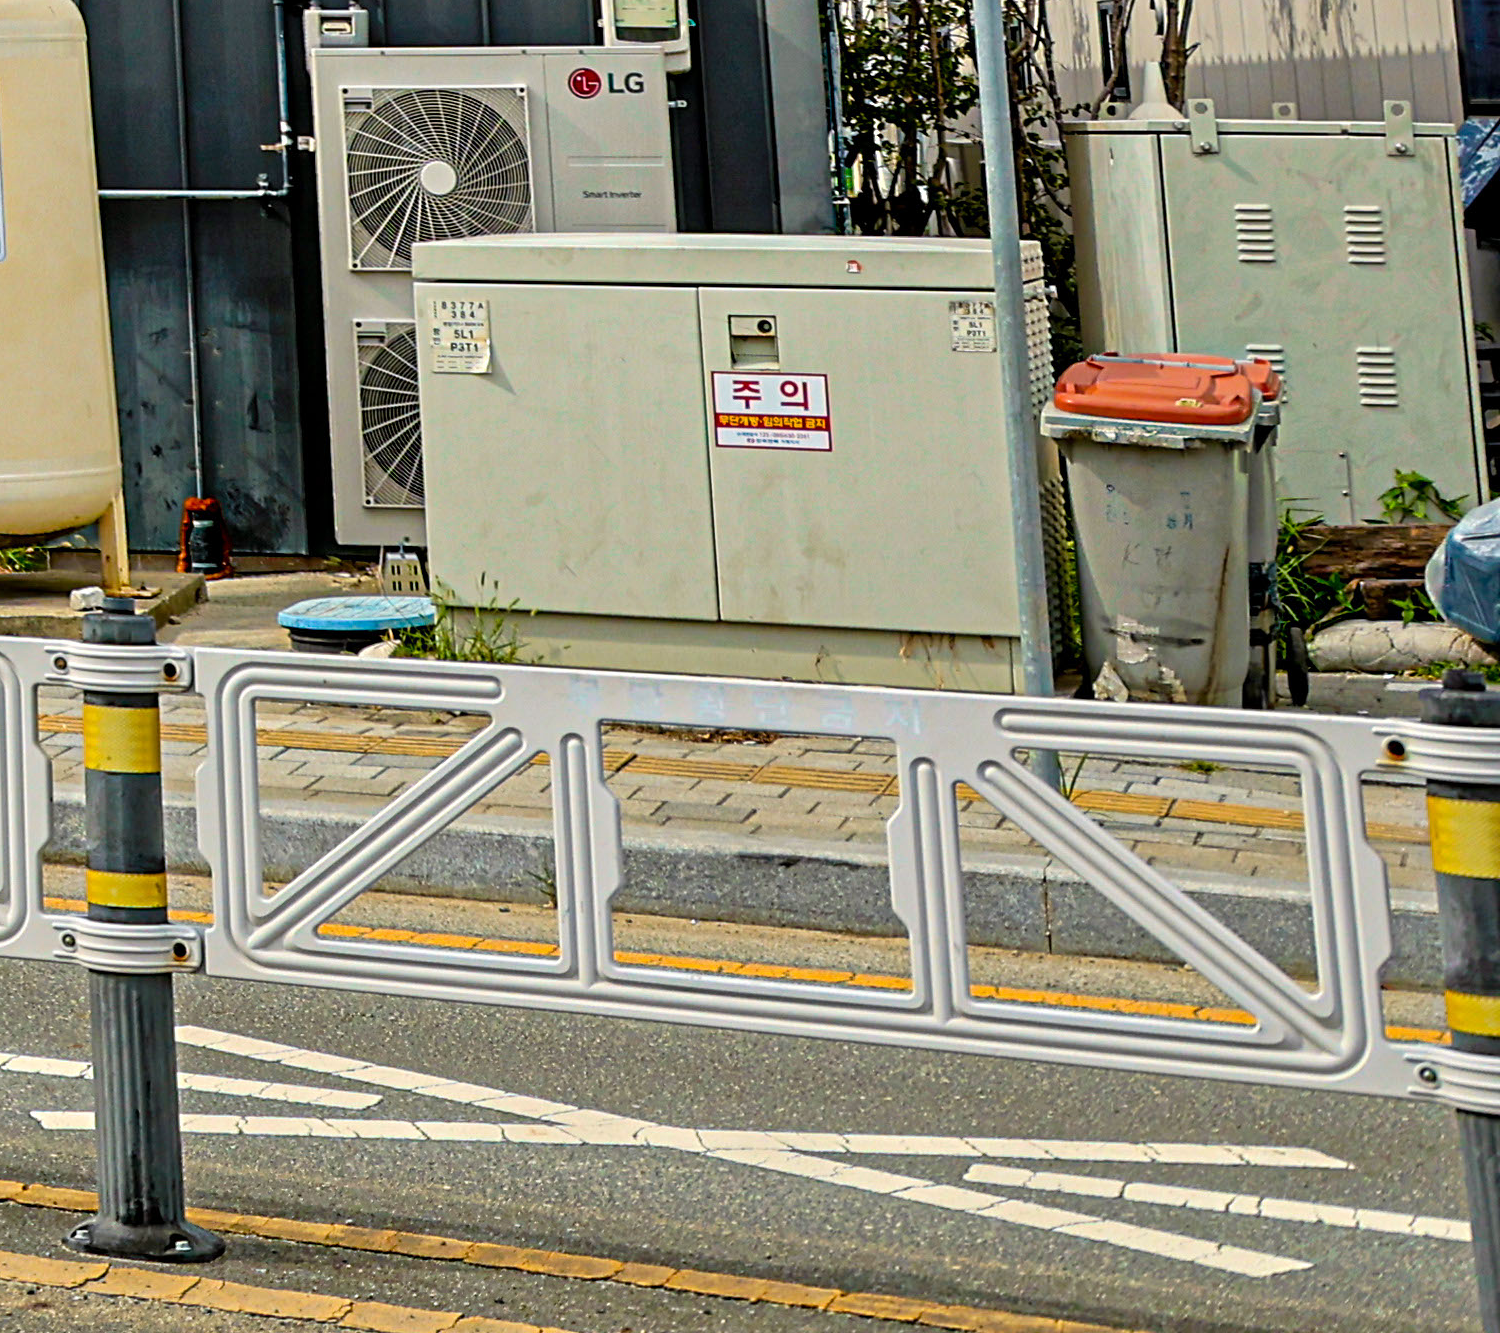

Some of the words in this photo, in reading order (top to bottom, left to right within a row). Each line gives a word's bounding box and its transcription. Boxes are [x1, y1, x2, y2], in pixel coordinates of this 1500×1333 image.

[607, 72, 645, 94] LG
[582, 190, 608, 199] Smart
[609, 190, 643, 199] Inverter
[450, 342, 479, 353] P3T1
[804, 417, 827, 430] 금지
